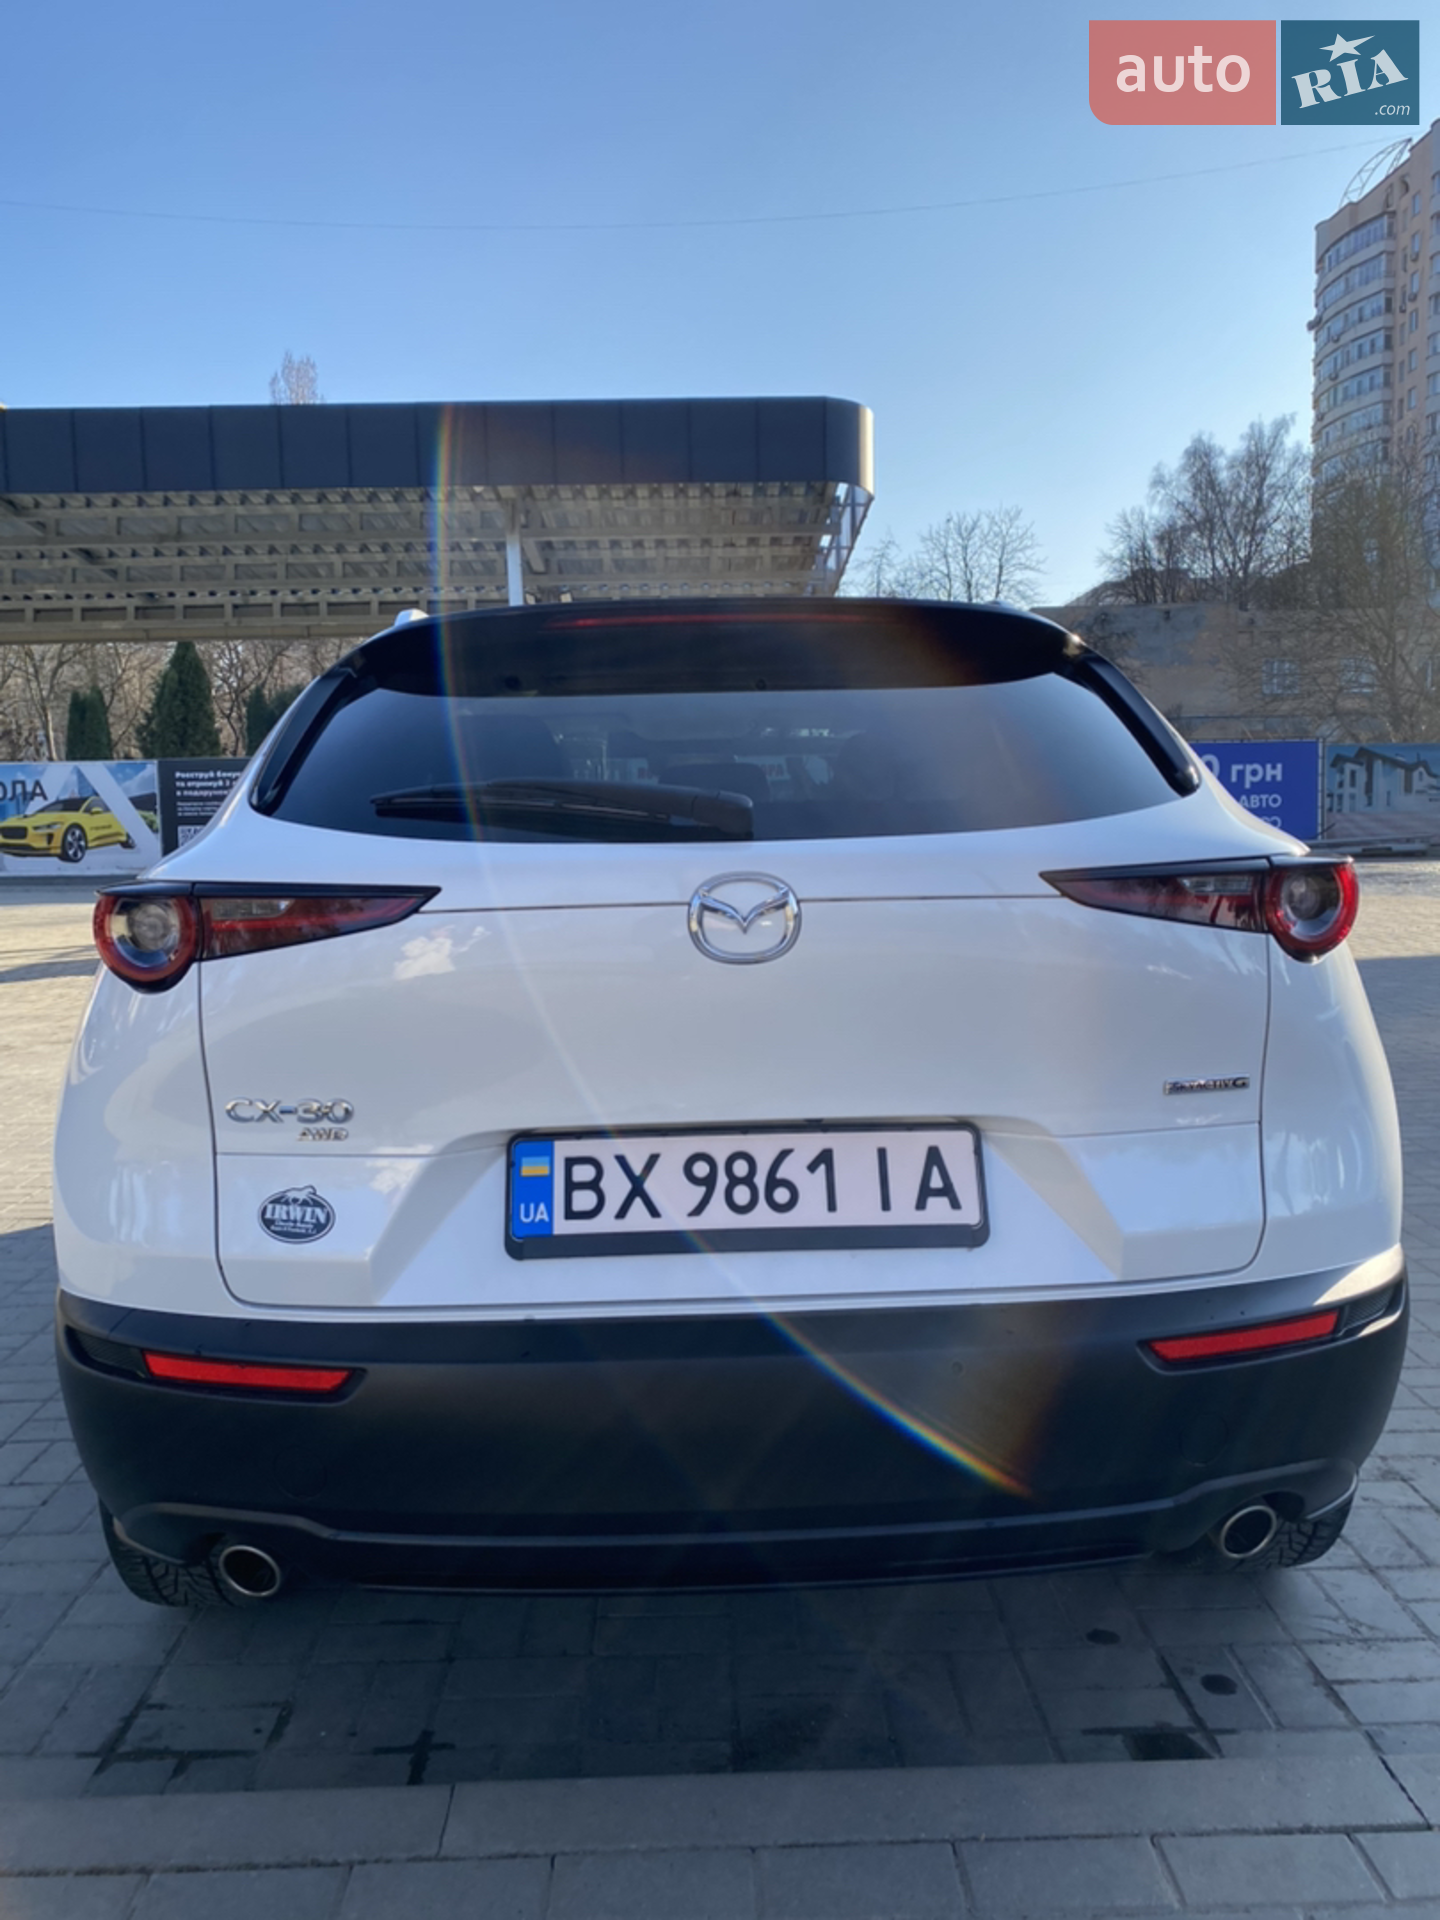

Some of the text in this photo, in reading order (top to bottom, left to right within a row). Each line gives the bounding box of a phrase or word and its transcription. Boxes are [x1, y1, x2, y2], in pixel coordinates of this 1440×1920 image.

[1231, 763, 1283, 789] грн
[1240, 794, 1282, 808] АВТО
[225, 1098, 354, 1125] CX-30
[297, 1127, 349, 1141] AWD
[563, 1153, 662, 1221] BX
[683, 1148, 838, 1218] 9861
[264, 1203, 328, 1224] IRWIN
[519, 1203, 549, 1224] UA
